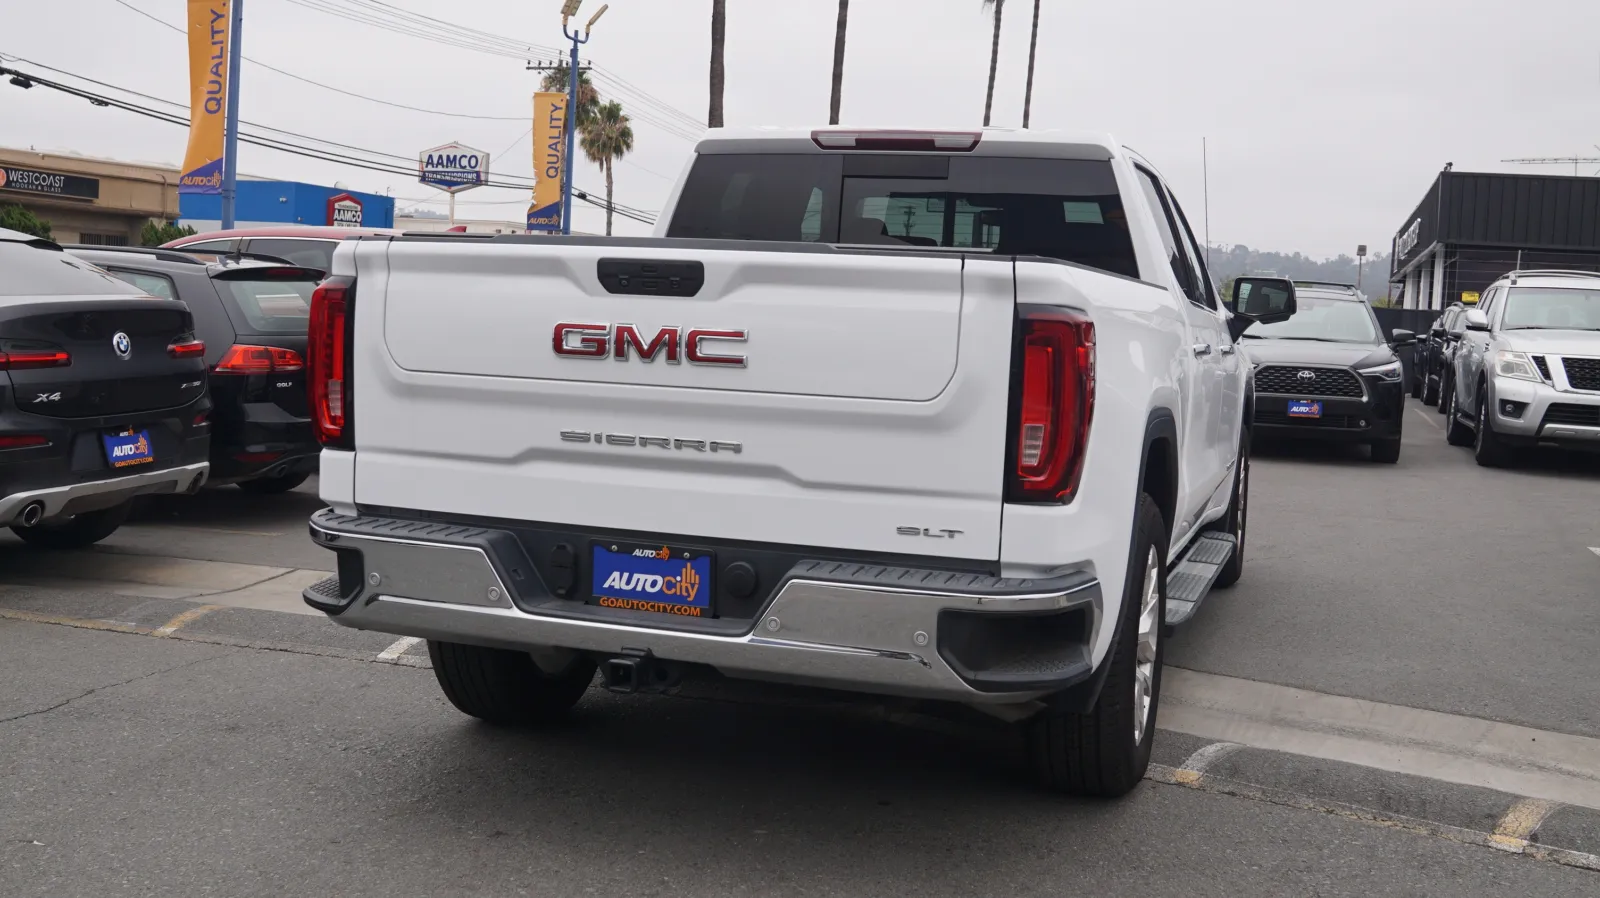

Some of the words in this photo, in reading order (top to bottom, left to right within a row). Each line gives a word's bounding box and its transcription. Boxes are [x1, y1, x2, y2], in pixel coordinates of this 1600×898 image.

[425, 153, 479, 169] AAMCO
[8, 169, 65, 187] WESTCOAST
[333, 209, 362, 223] AAMCO
[552, 320, 749, 369] GMC
[32, 391, 62, 403] X4
[560, 428, 743, 454] SIERRA
[896, 525, 965, 540] SLT
[599, 596, 701, 617] GOAUTOCITY.COM
